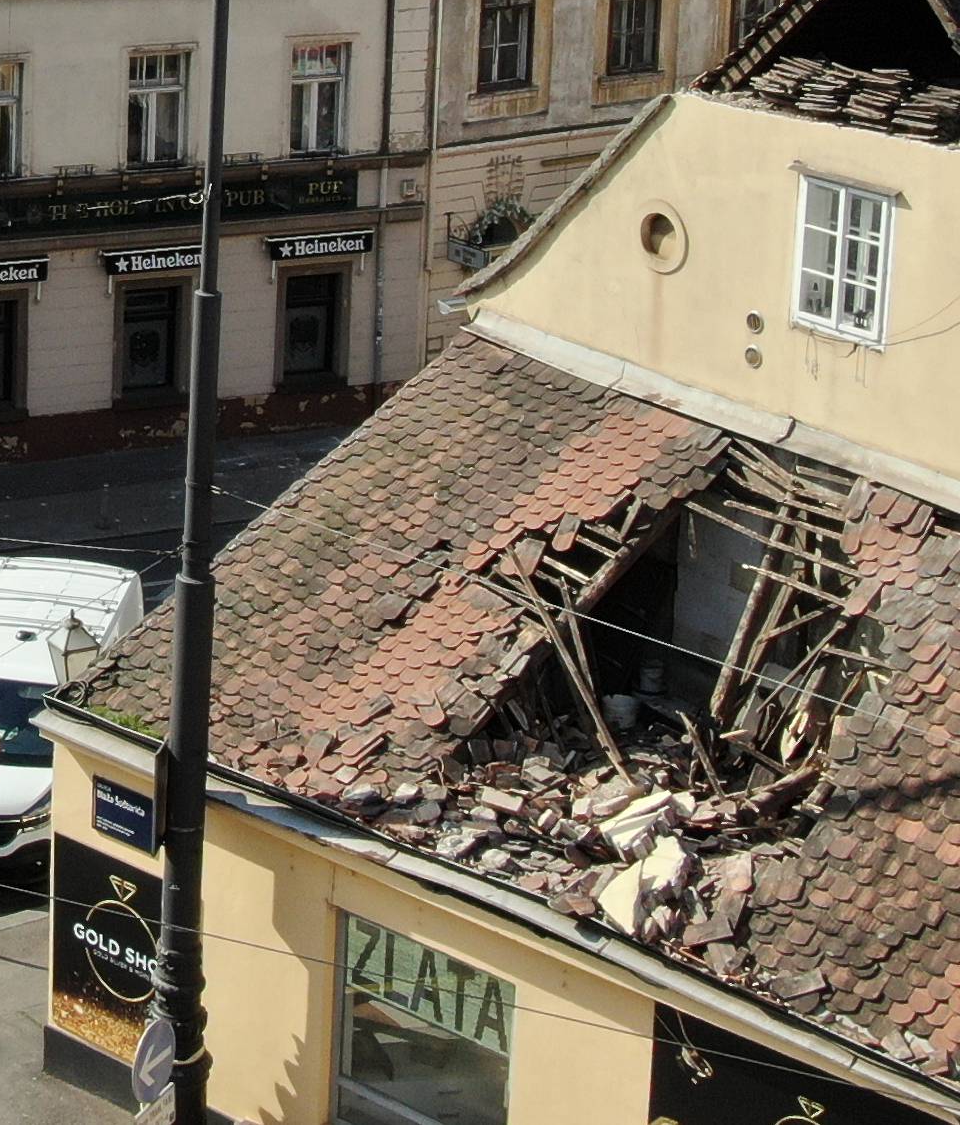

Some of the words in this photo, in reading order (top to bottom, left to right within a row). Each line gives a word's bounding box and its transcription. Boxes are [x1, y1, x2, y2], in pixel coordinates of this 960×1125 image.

[95, 198, 135, 219] HOL
[225, 189, 265, 207] PUB
[294, 236, 365, 256] Heineken
[73, 923, 121, 956] GOLD
[125, 947, 158, 975] SHO
[351, 919, 508, 1054] ZLATA
